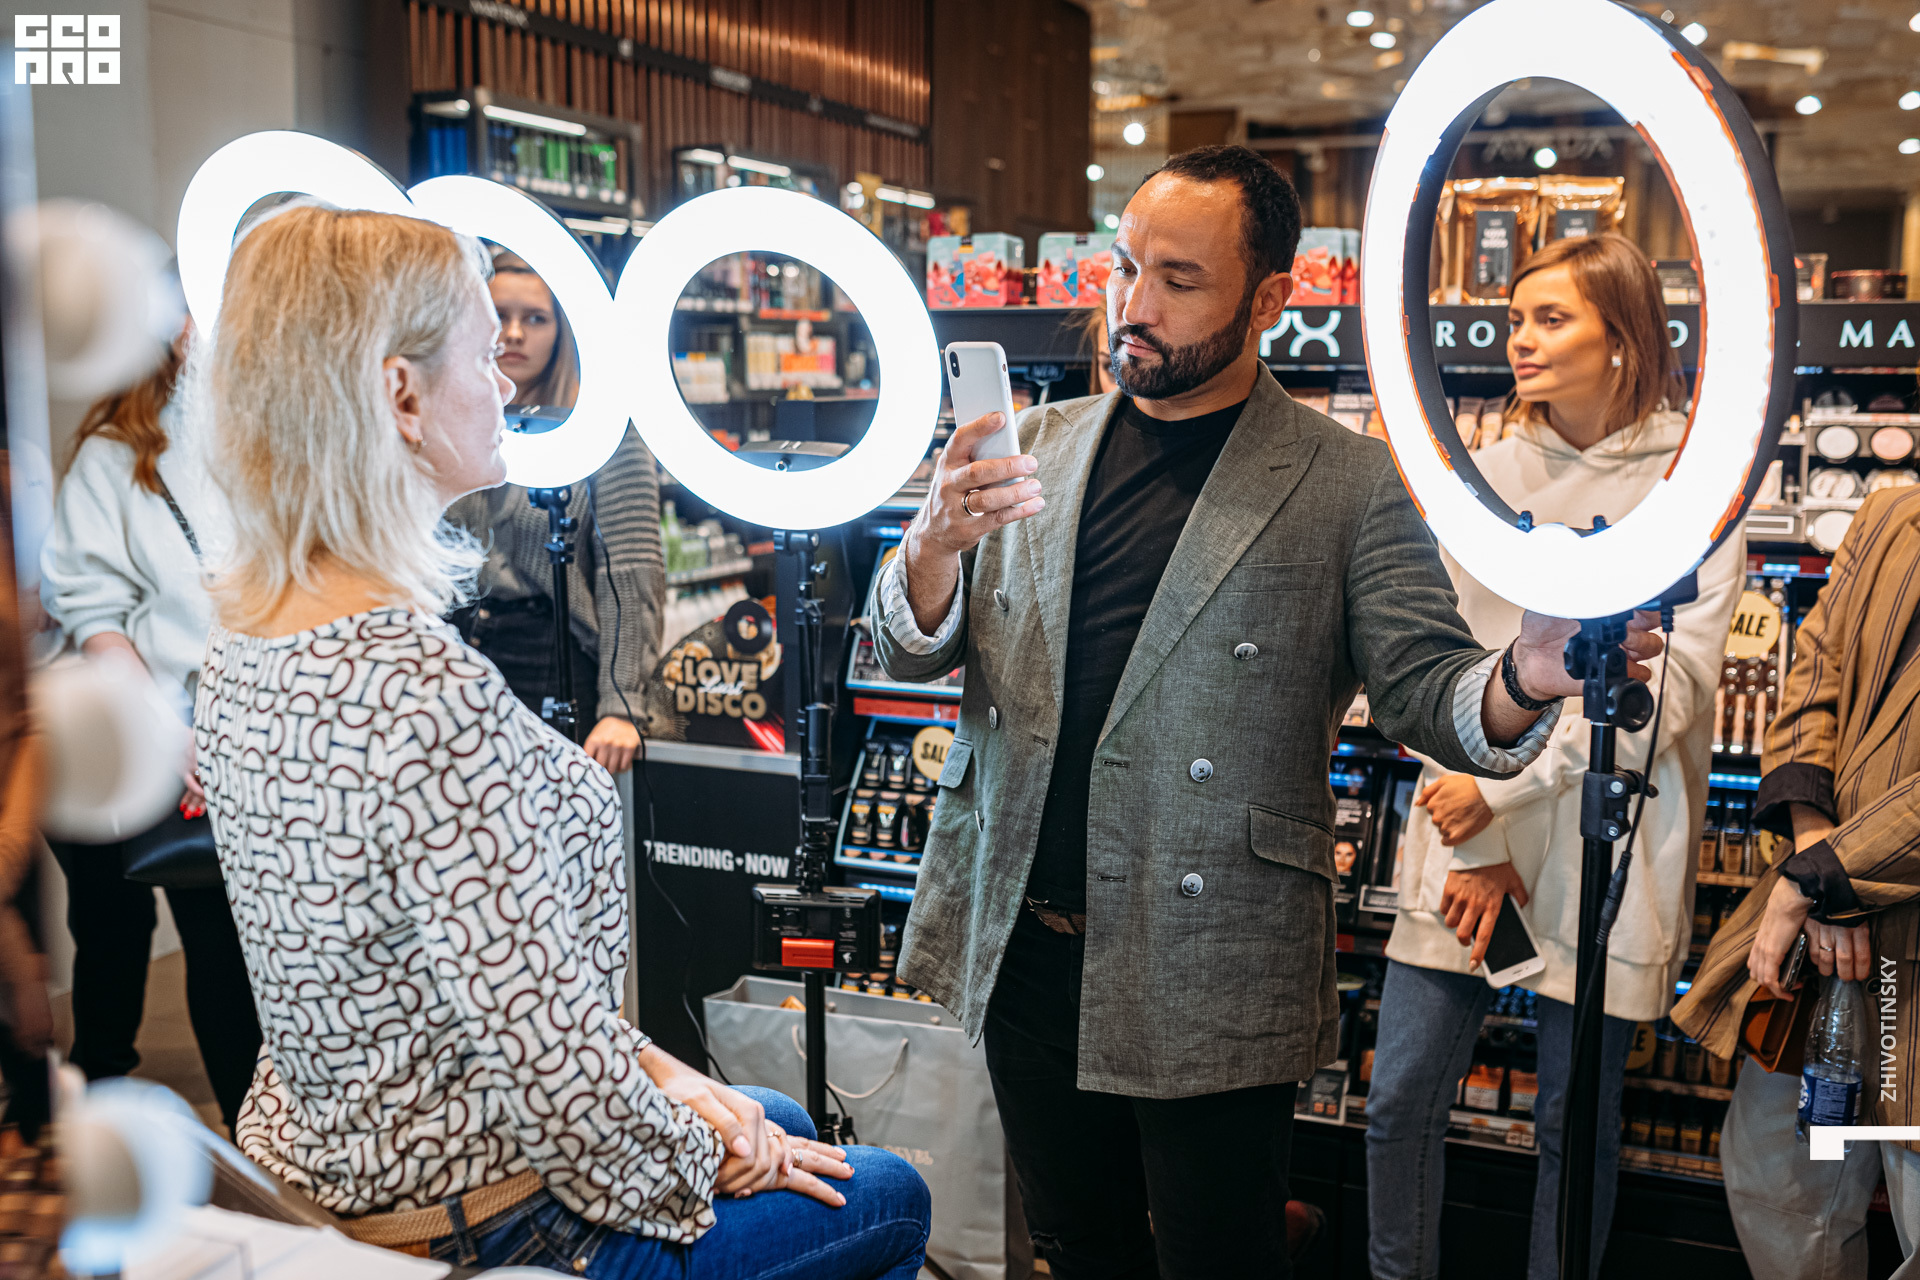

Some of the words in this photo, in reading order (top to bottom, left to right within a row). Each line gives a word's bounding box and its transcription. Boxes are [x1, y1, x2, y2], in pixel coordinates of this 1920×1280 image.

[1258, 310, 1342, 358] YX
[1729, 612, 1770, 637] ALE
[684, 657, 759, 691] LOVE
[676, 685, 766, 720] DISCO
[921, 741, 950, 764] SAL
[744, 852, 790, 878] NOW
